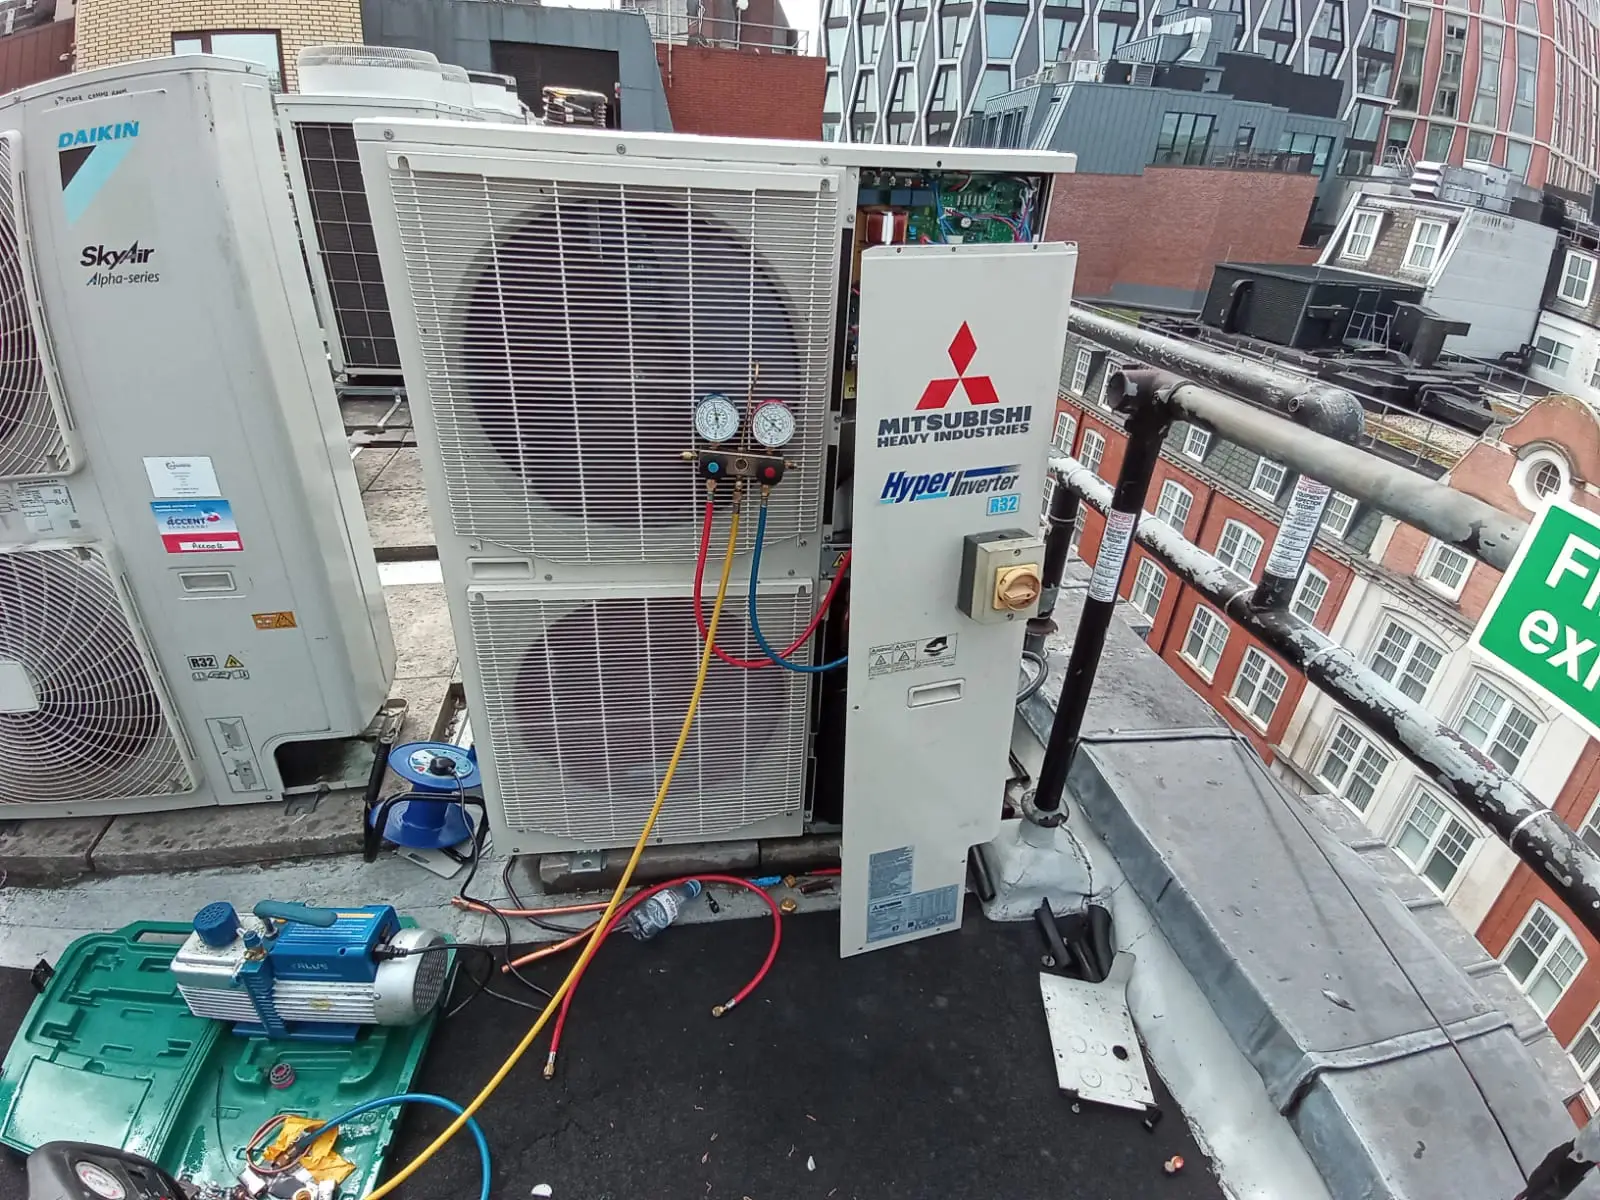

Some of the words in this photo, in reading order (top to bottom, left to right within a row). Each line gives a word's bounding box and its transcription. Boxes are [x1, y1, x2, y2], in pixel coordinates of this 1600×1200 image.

[58, 121, 139, 147] DAIKIN
[86, 271, 160, 288] Alpha-series
[877, 405, 1033, 436] MITSUBISHI
[877, 432, 930, 448] HEAVY
[933, 422, 1030, 442] INDUSTRIES
[880, 469, 957, 504] Hyper
[948, 469, 1020, 497] Inverter
[989, 495, 1018, 513] R32
[190, 657, 216, 668] R32
